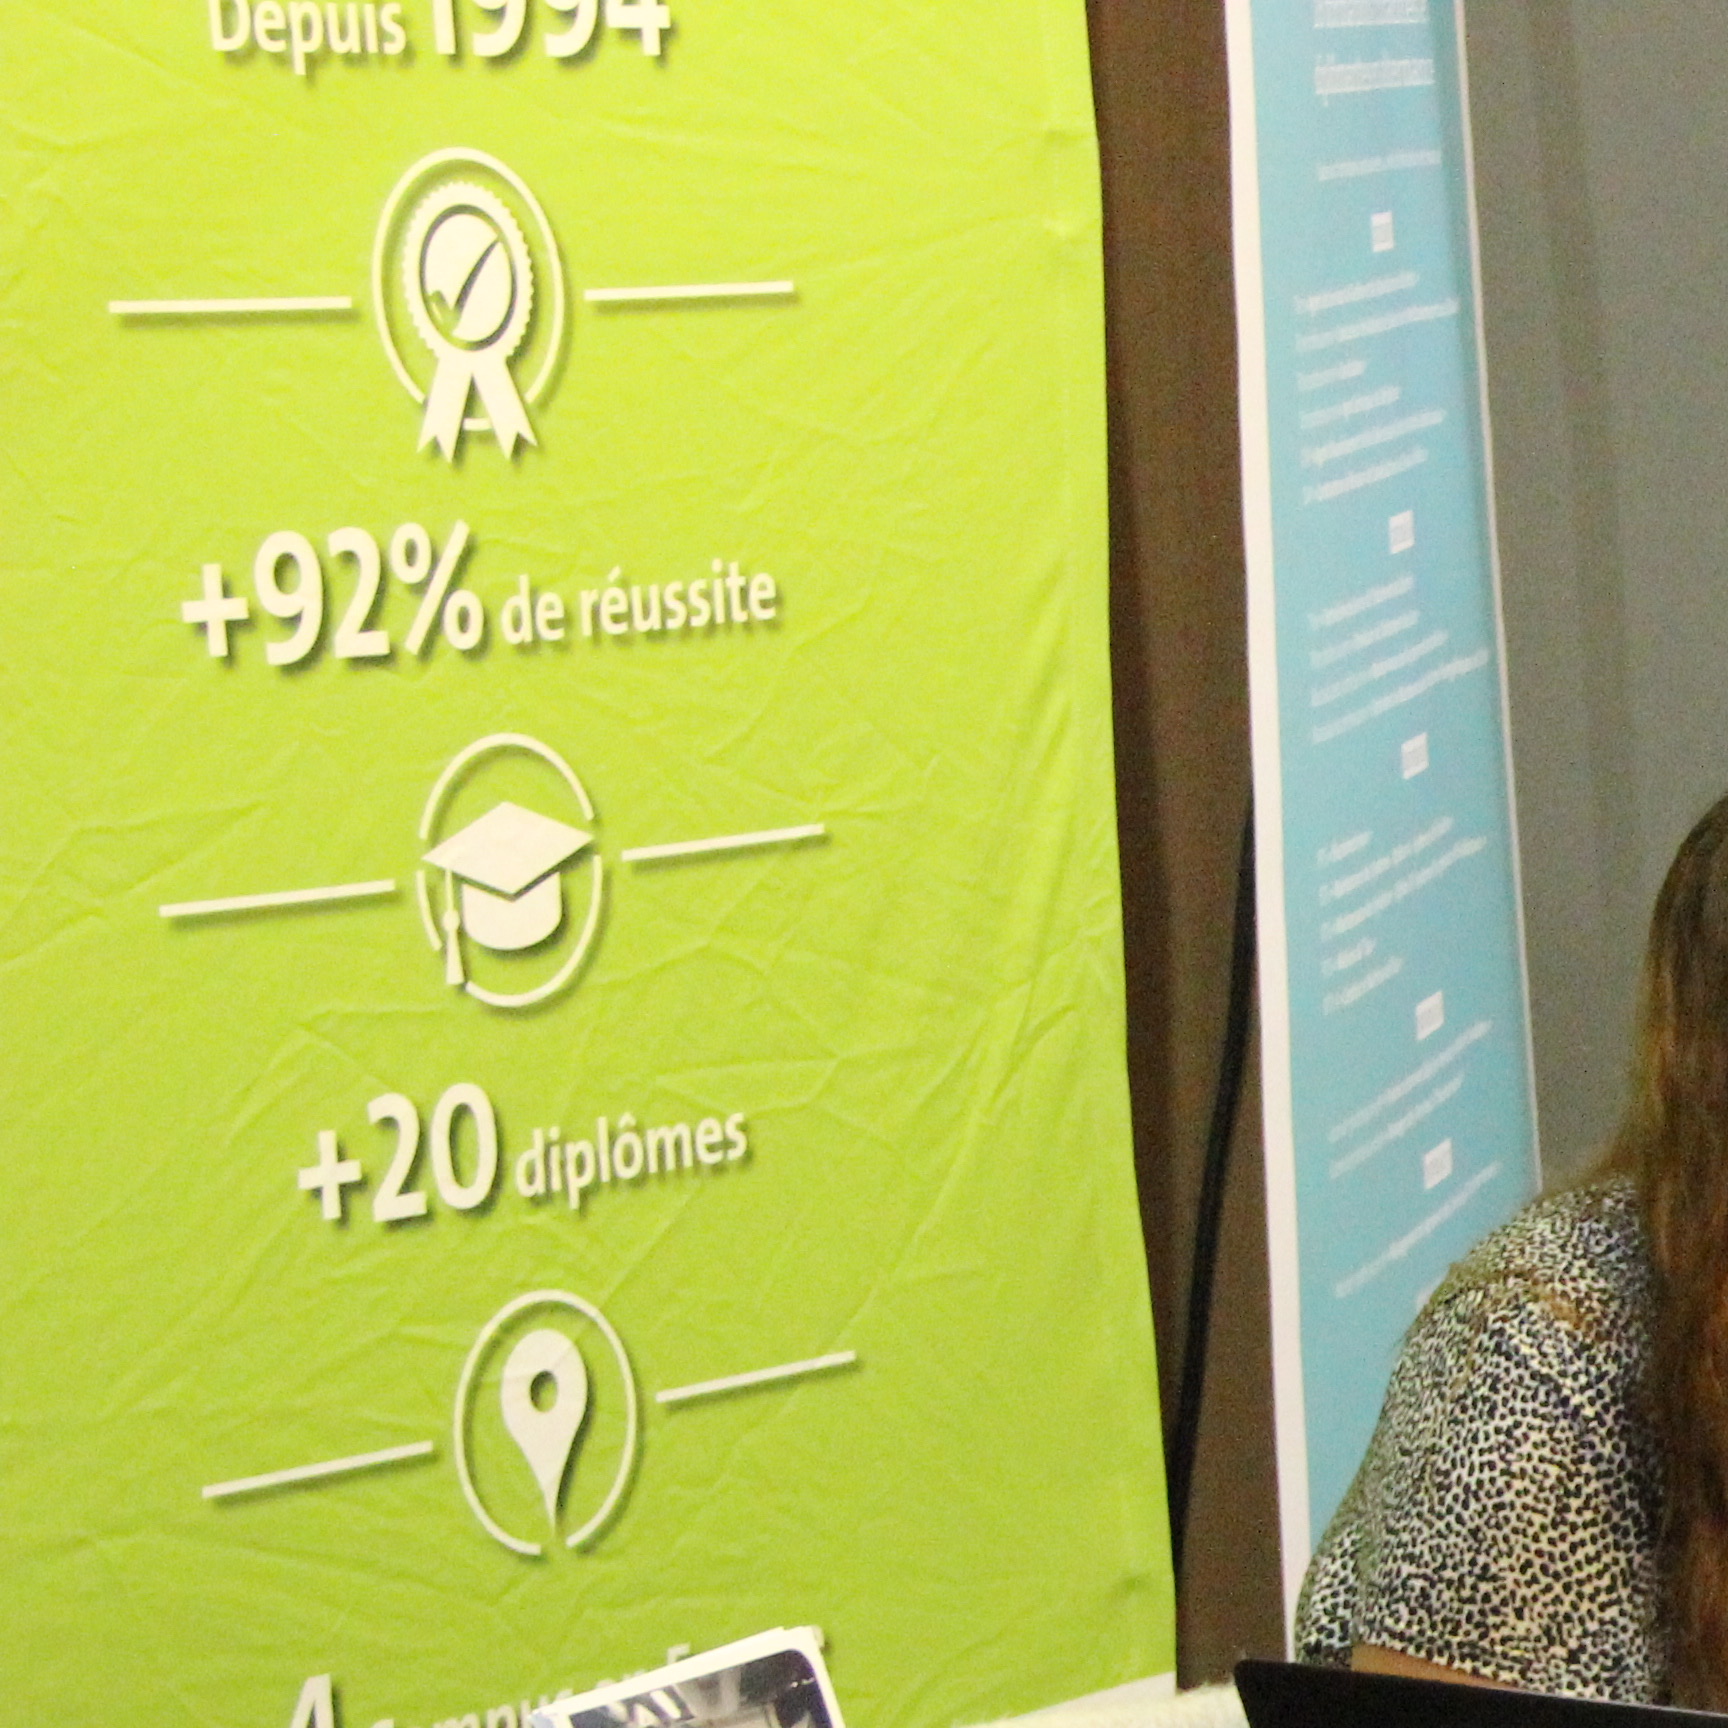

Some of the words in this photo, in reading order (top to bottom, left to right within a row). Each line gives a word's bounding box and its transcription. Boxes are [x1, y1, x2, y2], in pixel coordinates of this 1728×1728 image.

[208, 0, 407, 76] Depuis
[183, 520, 483, 667] +92%
[501, 574, 565, 647] de
[579, 557, 778, 641] réussite
[298, 1083, 500, 1223] +20
[516, 1108, 749, 1209] diplômes
